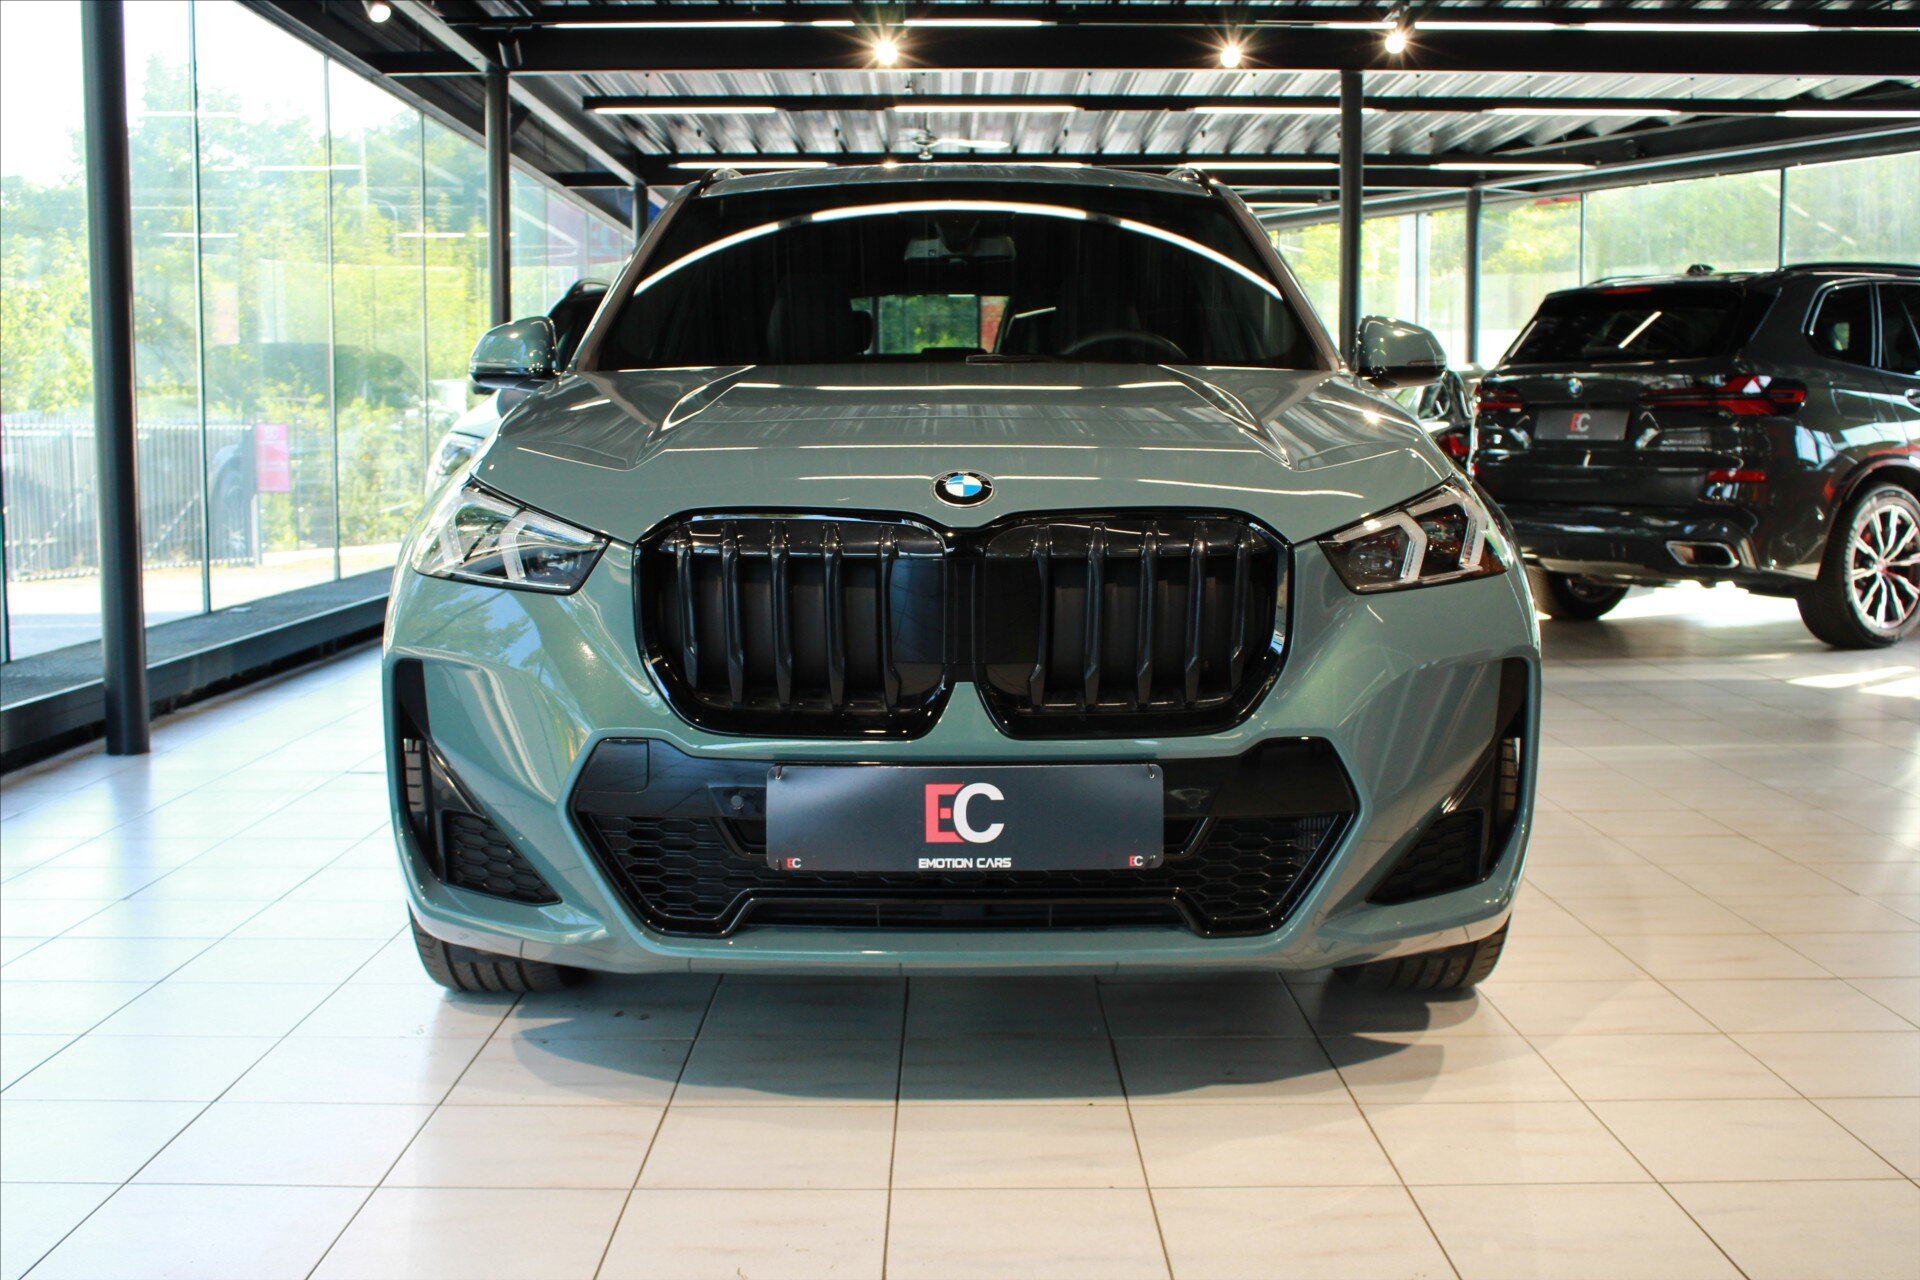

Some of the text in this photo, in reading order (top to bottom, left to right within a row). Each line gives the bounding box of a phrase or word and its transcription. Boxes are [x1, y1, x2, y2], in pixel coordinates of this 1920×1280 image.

[925, 782, 1004, 844] EC
[786, 857, 802, 869] EC
[918, 857, 1012, 869] EMOTION CARS
[1128, 855, 1144, 867] EC
